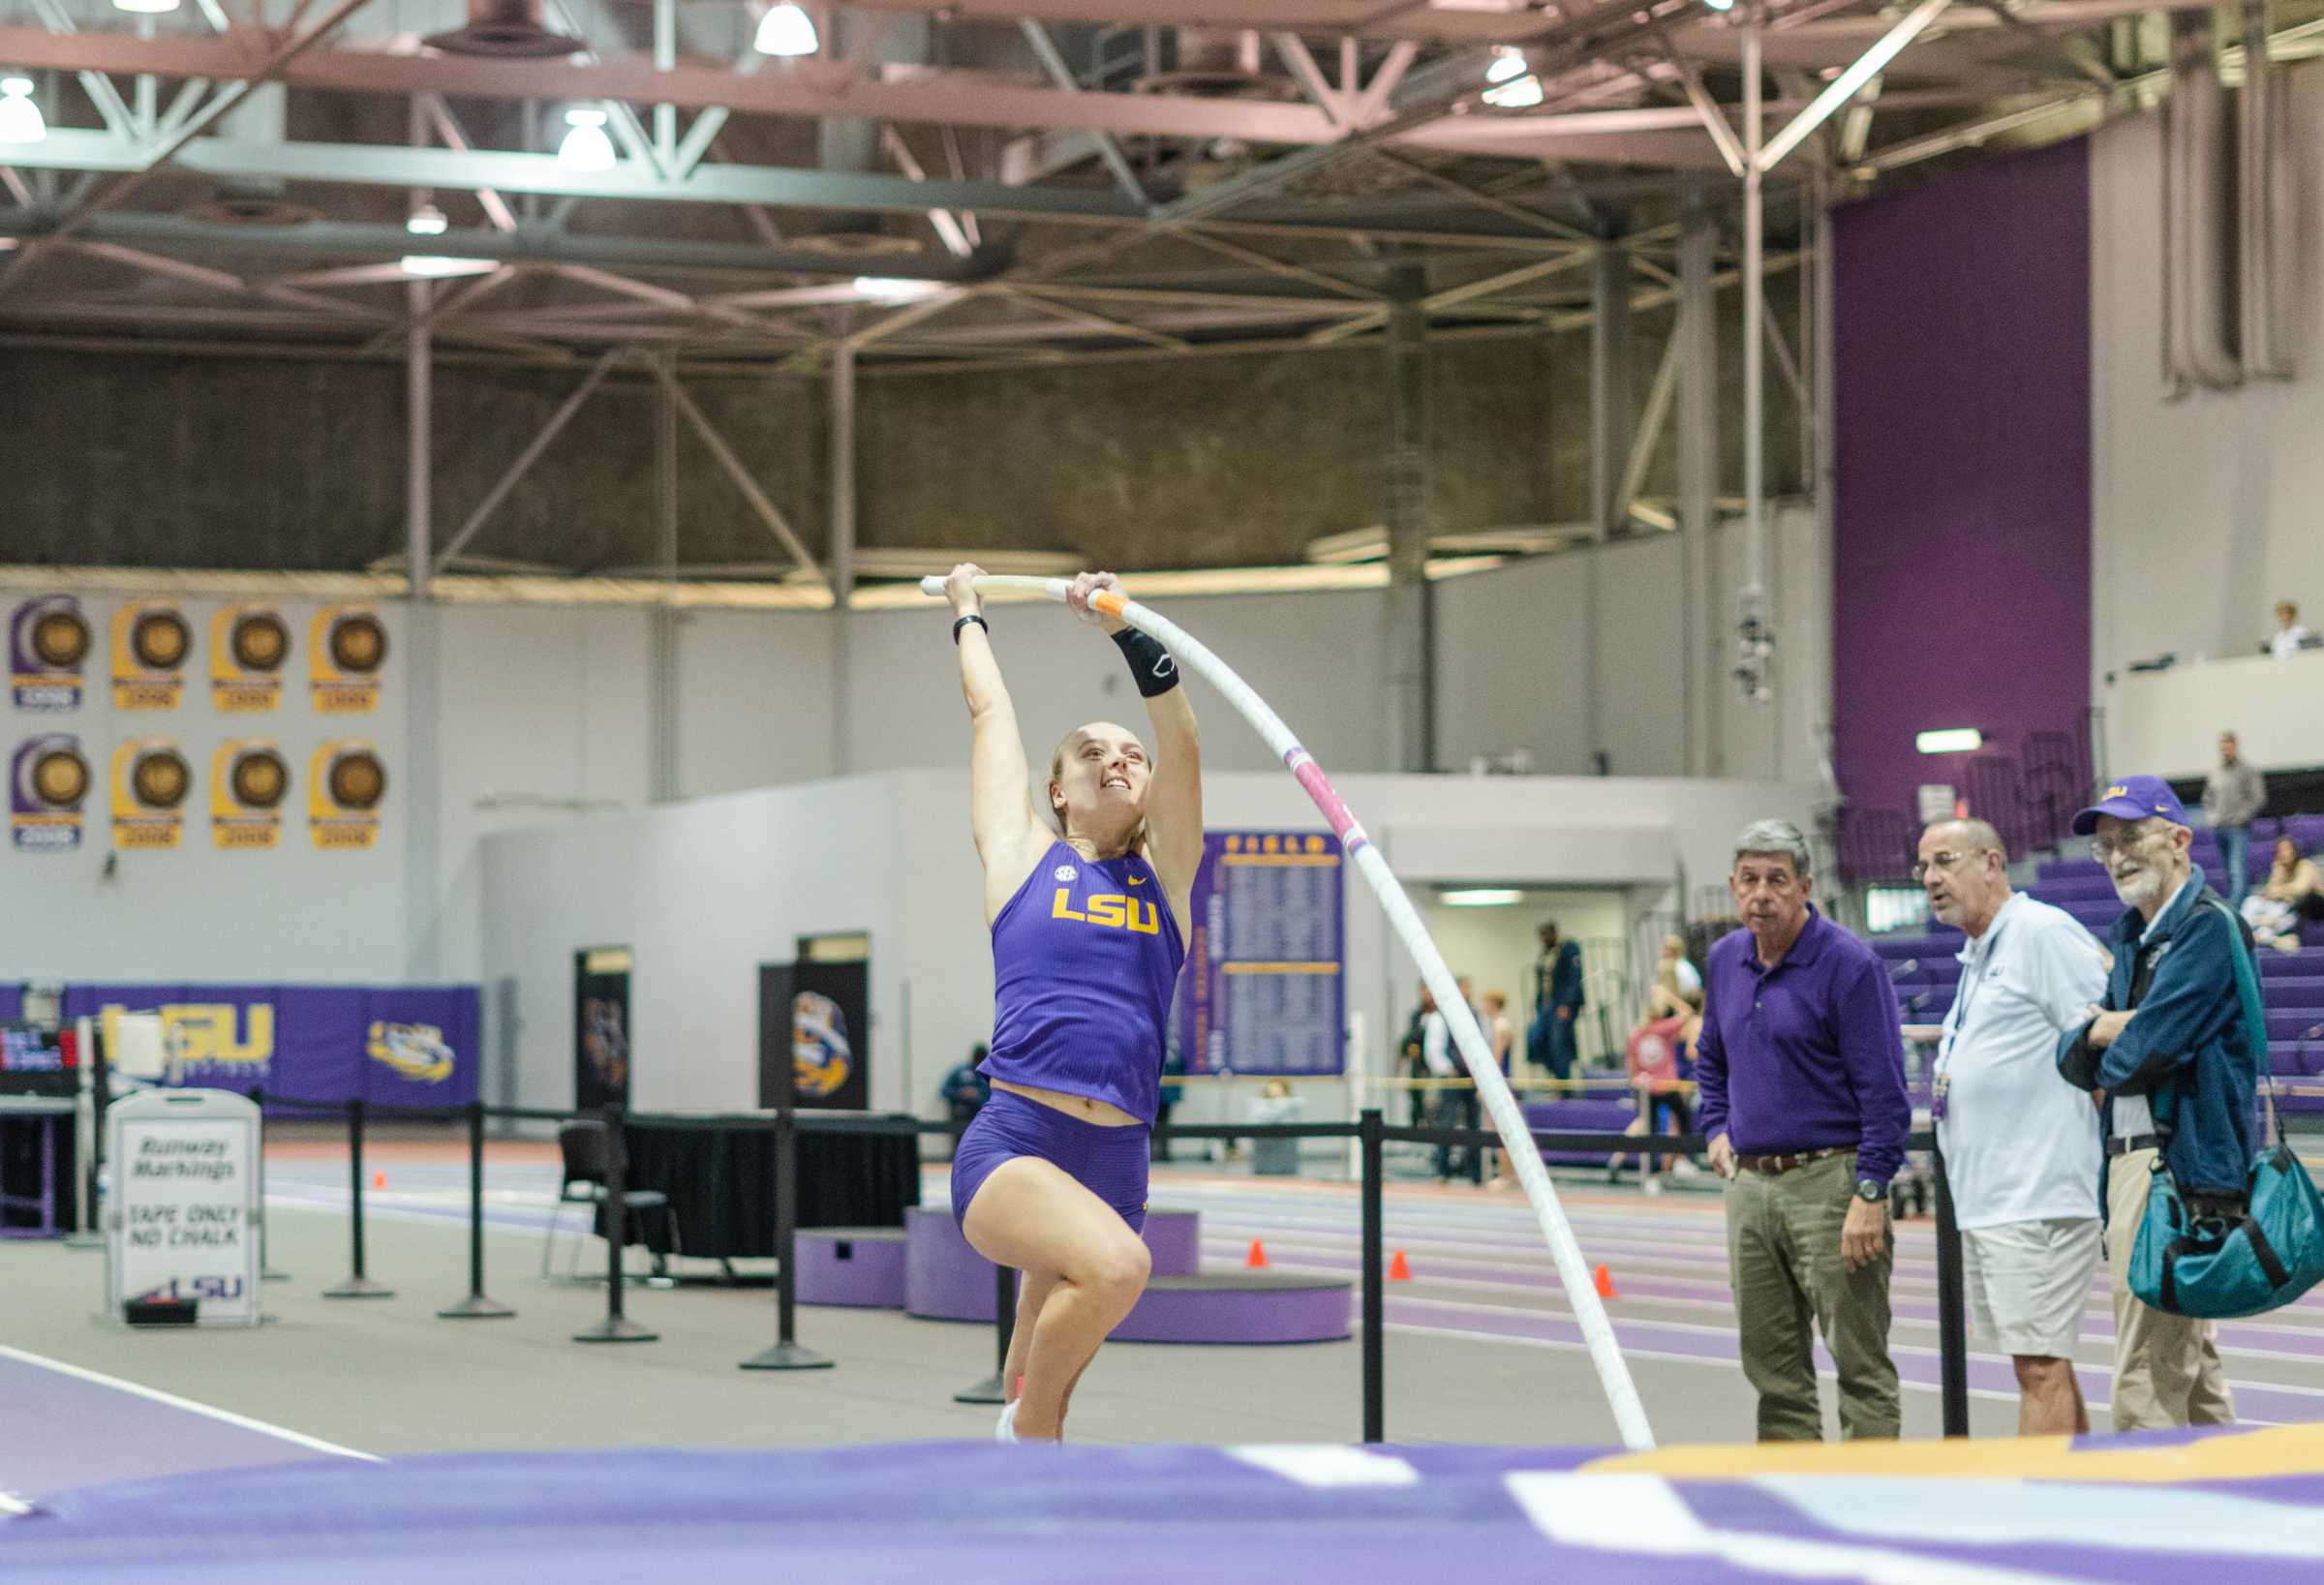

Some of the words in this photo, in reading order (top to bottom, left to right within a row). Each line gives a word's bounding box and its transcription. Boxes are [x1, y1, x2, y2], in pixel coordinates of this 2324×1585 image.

[1053, 887, 1159, 935] LSU
[140, 1137, 229, 1157] Runway
[133, 1160, 235, 1181] Markings
[187, 1204, 241, 1224] ONLY
[129, 1228, 162, 1246] NO
[169, 1228, 238, 1246] CHALK
[170, 1275, 243, 1297] LSU
